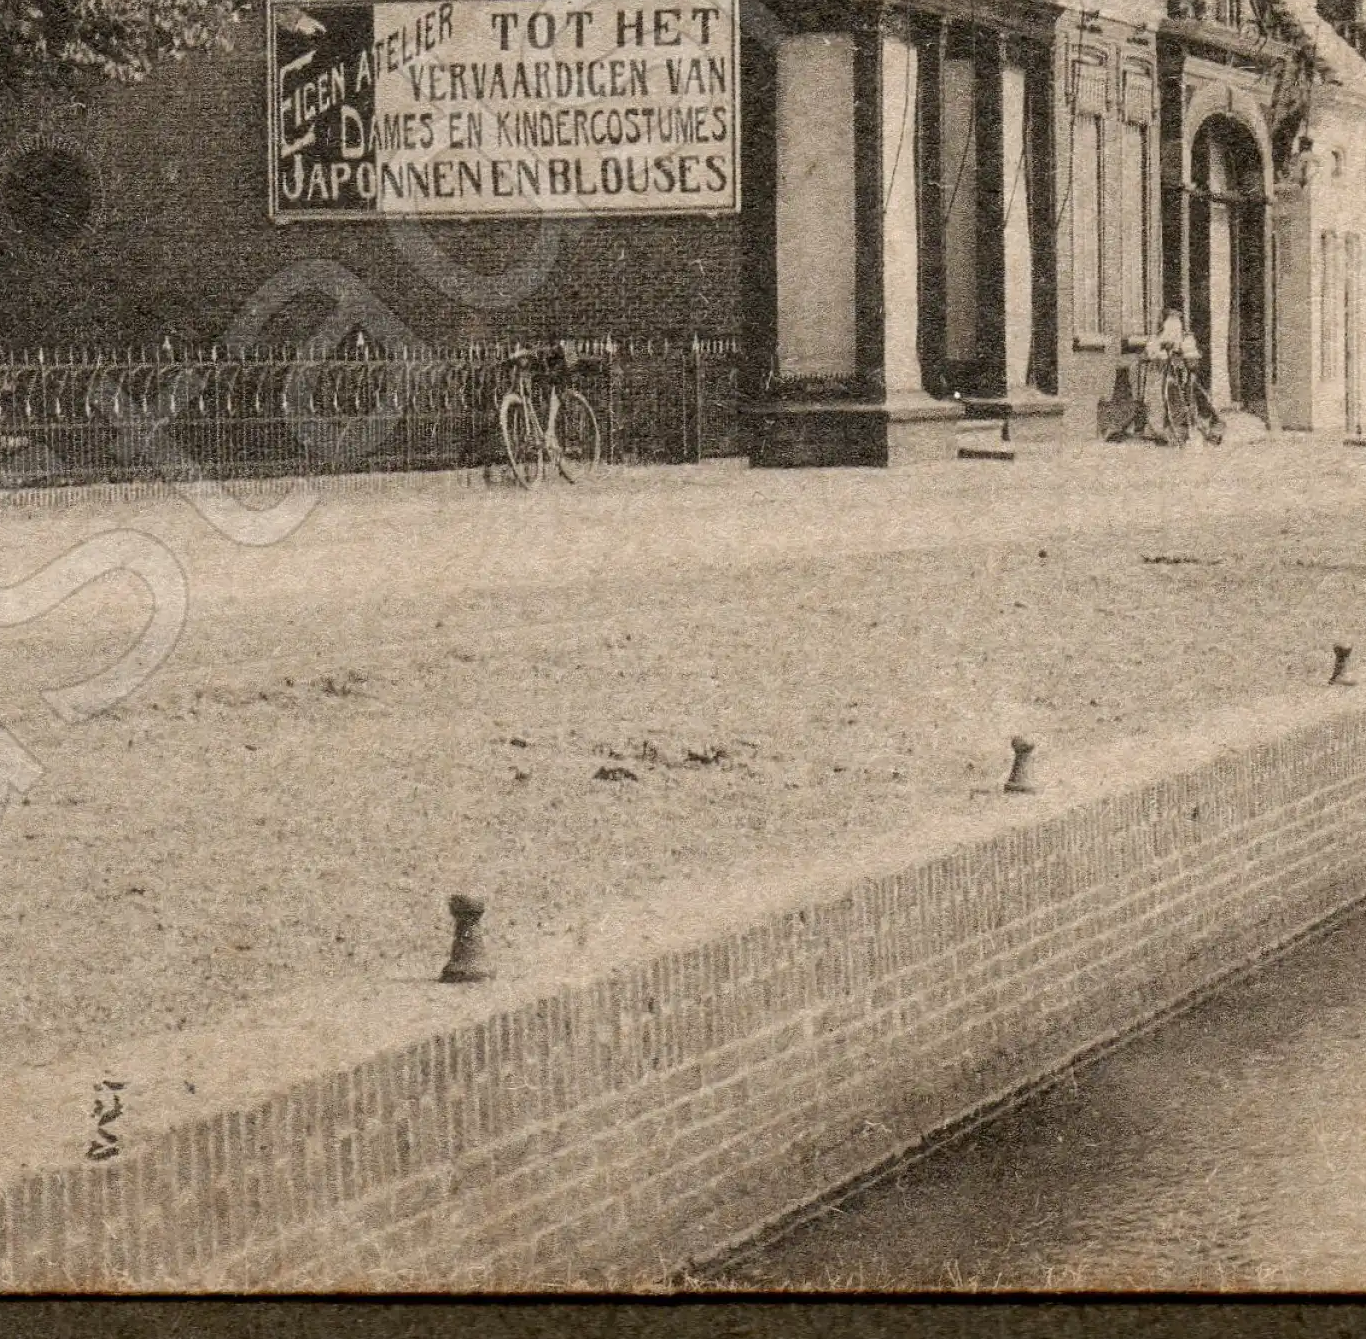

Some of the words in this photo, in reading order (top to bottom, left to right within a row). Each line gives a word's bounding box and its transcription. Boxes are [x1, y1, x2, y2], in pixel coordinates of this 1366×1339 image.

[491, 11, 593, 50] TOT
[616, 7, 719, 48] HET
[279, 49, 346, 158] EIGEN
[356, 2, 453, 92] ATELIER
[408, 59, 648, 102] VERVAARDIGEN
[665, 56, 726, 95] VAN
[340, 104, 434, 160] DAMES
[448, 111, 484, 150] EN
[496, 105, 728, 148] KINDERCOSTUMES
